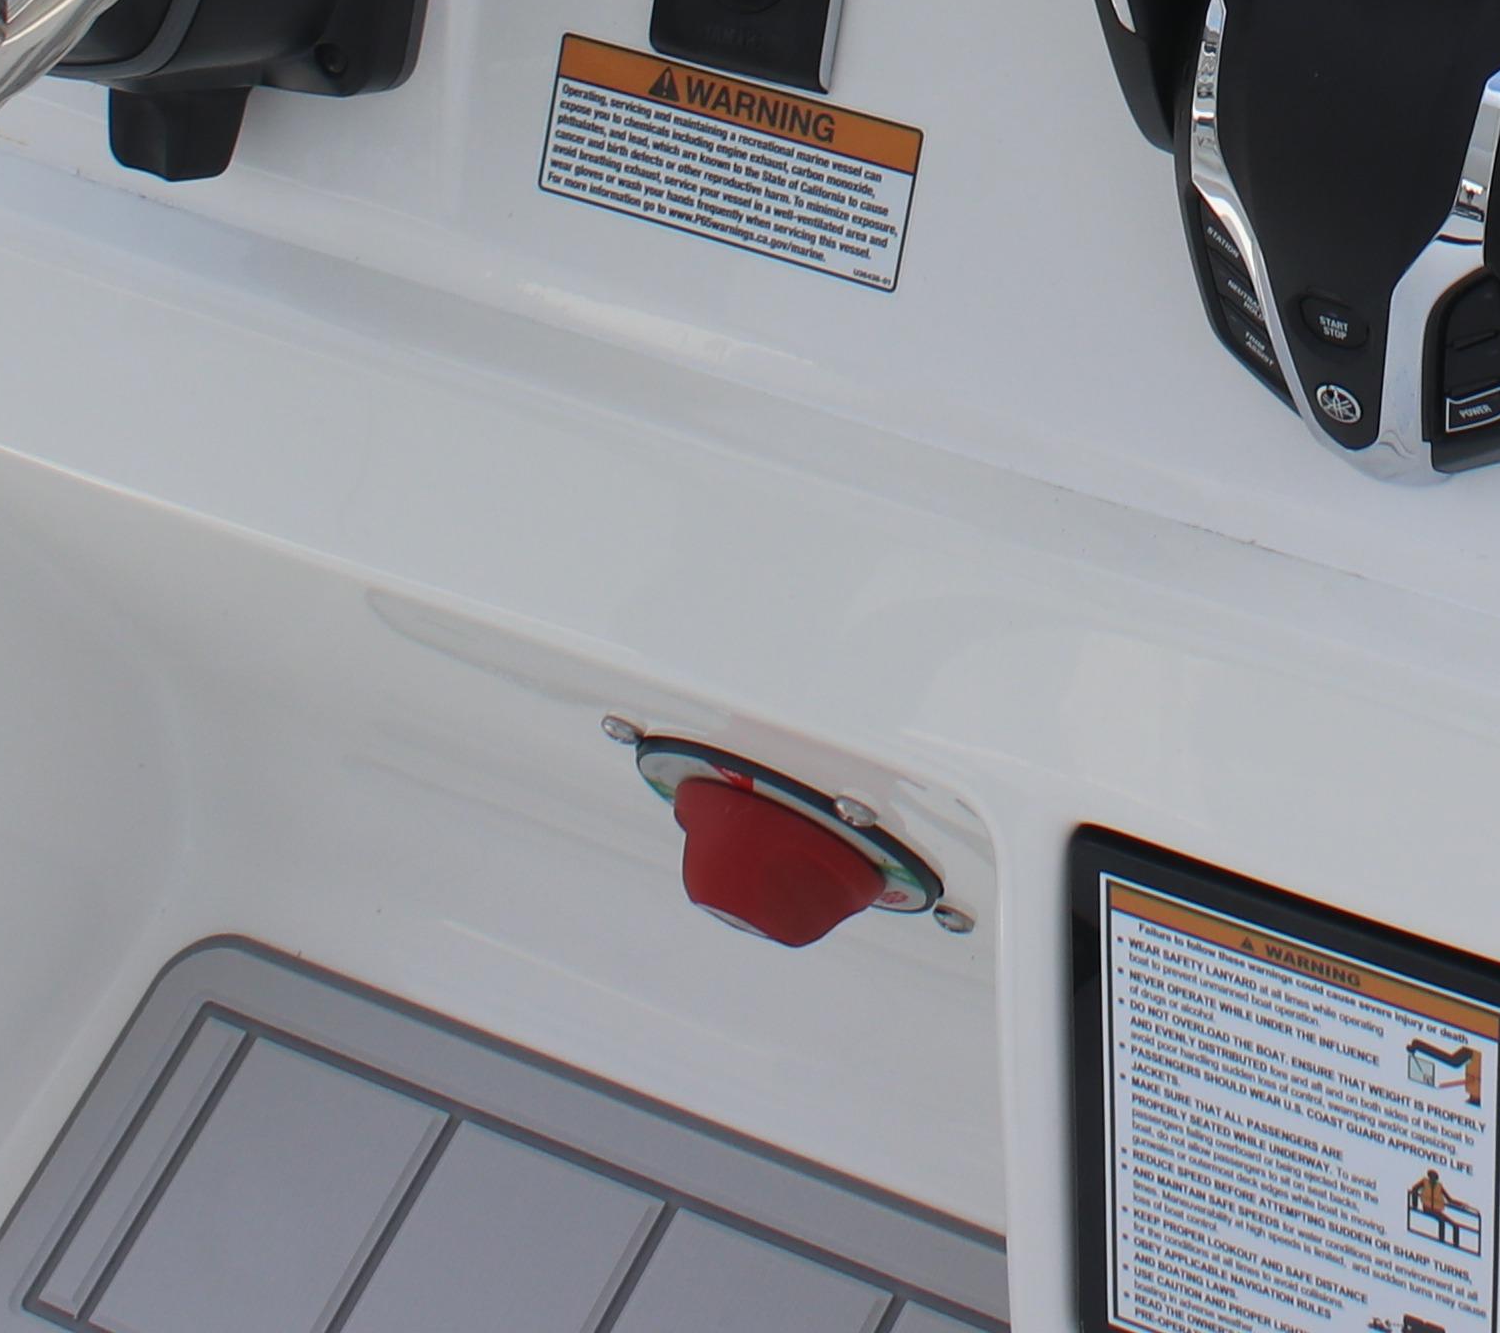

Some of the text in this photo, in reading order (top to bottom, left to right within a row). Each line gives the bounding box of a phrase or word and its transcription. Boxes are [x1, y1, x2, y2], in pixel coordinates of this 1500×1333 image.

[685, 74, 835, 144] WARNING
[1208, 224, 1241, 258] STATION
[1227, 278, 1261, 308] NEUTRA
[1319, 315, 1348, 332] START
[1323, 325, 1348, 340] STOP
[1458, 404, 1493, 420] POWER
[1265, 944, 1361, 988] WARNING
